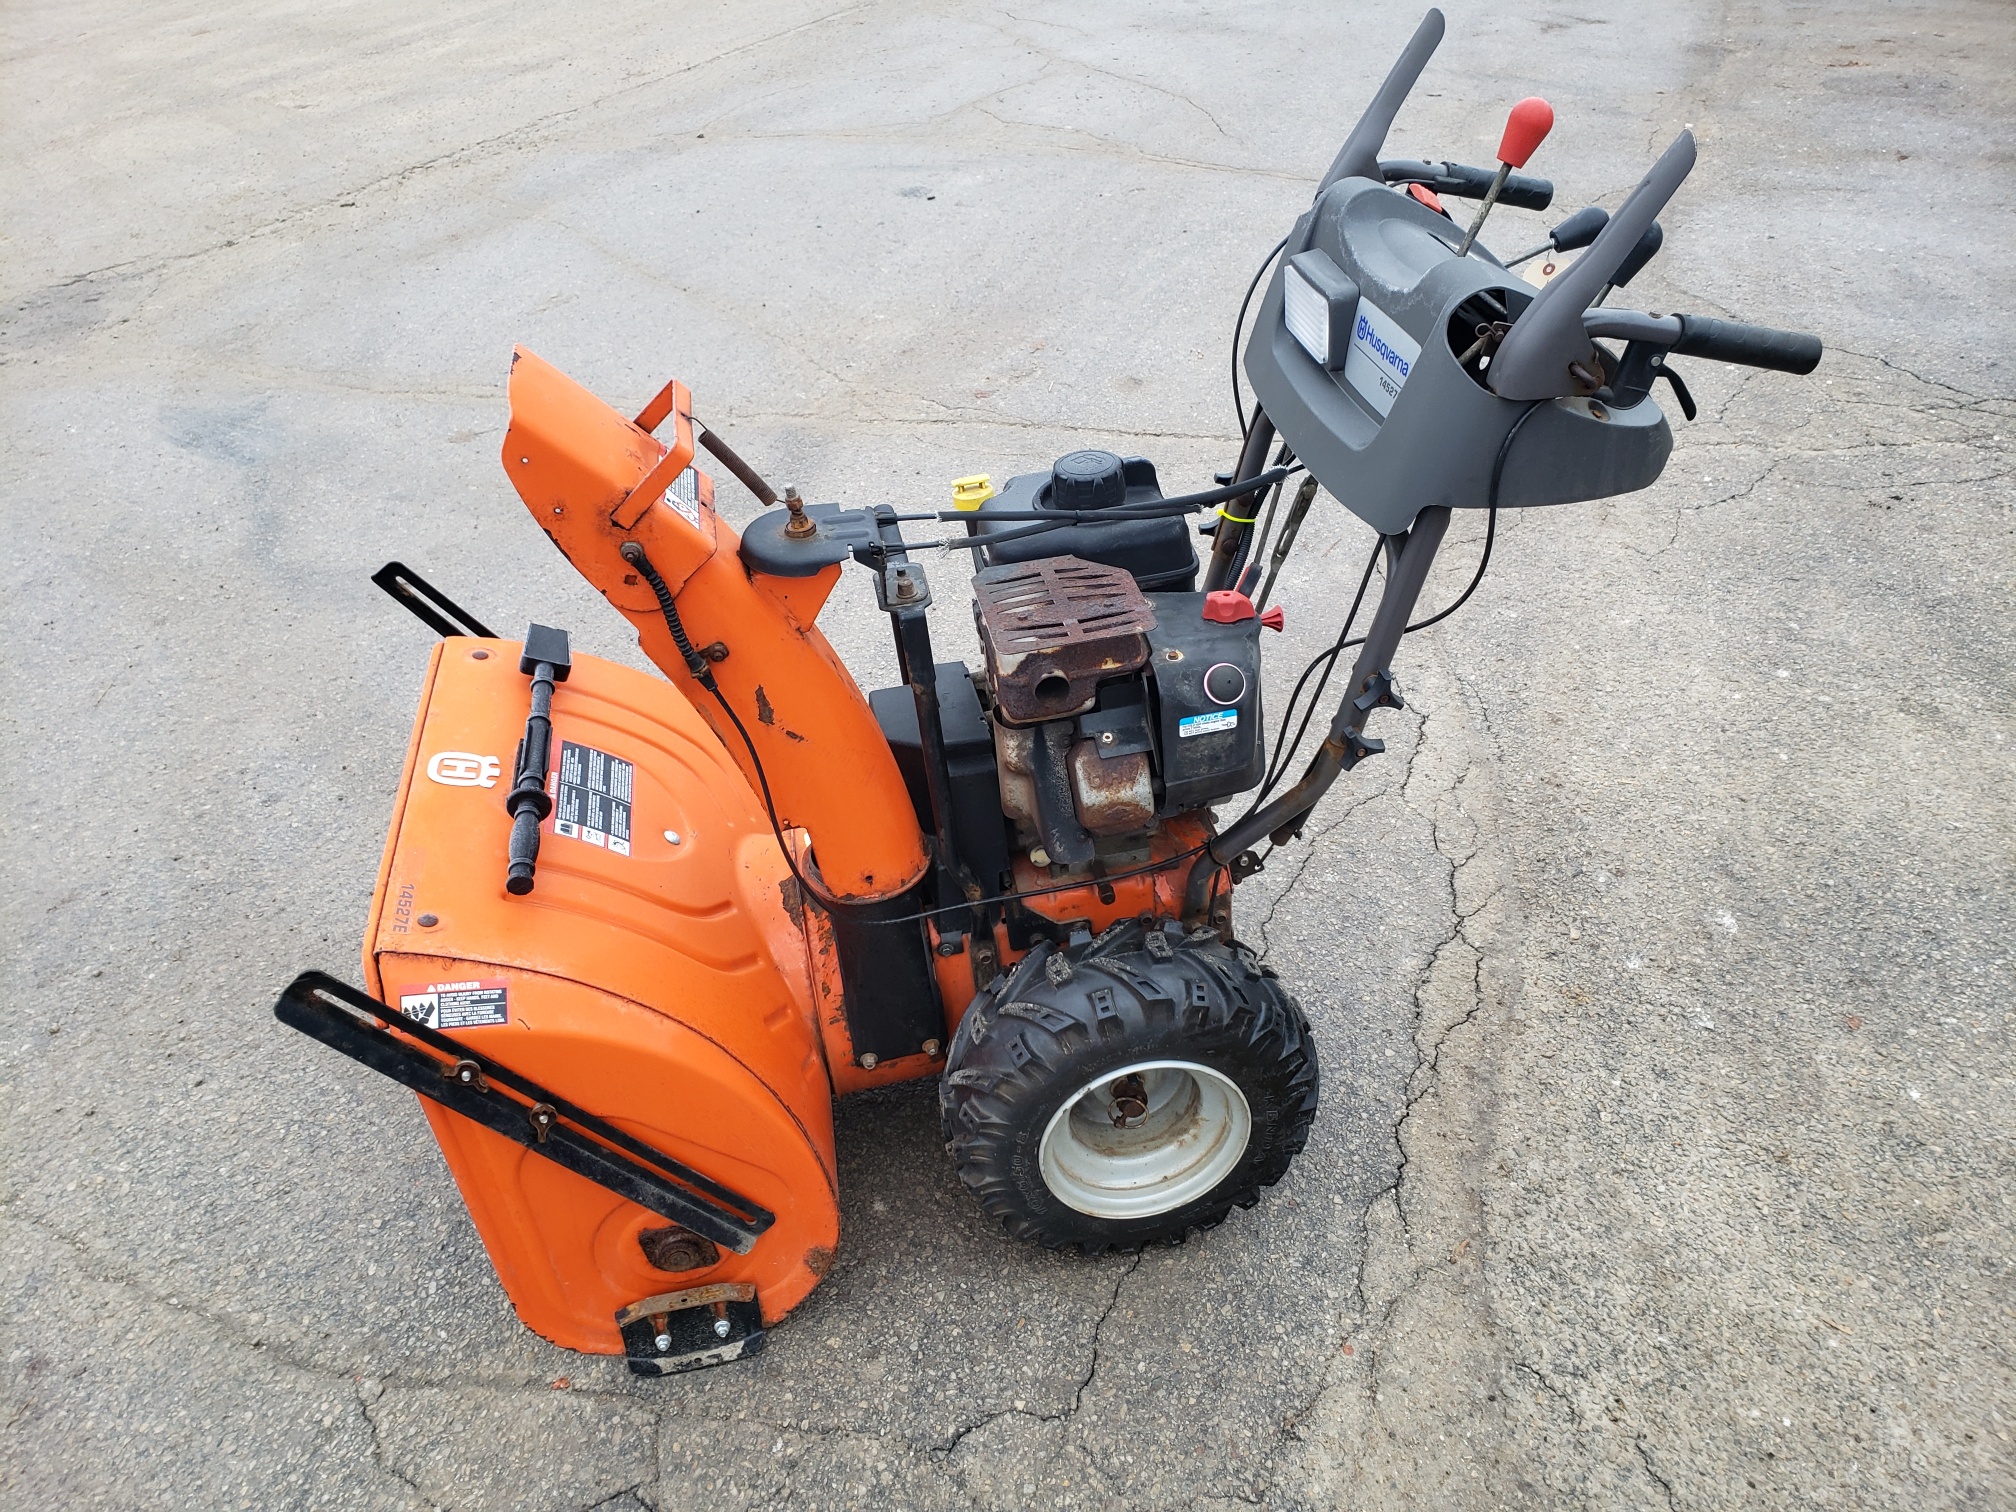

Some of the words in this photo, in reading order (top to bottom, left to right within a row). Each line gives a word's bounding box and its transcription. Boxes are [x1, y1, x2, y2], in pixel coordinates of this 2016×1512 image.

[1366, 325, 1409, 378] Husqvarna
[1380, 376, 1398, 399] 14527
[1193, 712, 1224, 724] NOTICE
[550, 771, 559, 794] DANGER
[392, 884, 414, 932] 14527E
[437, 981, 480, 992] DANGER
